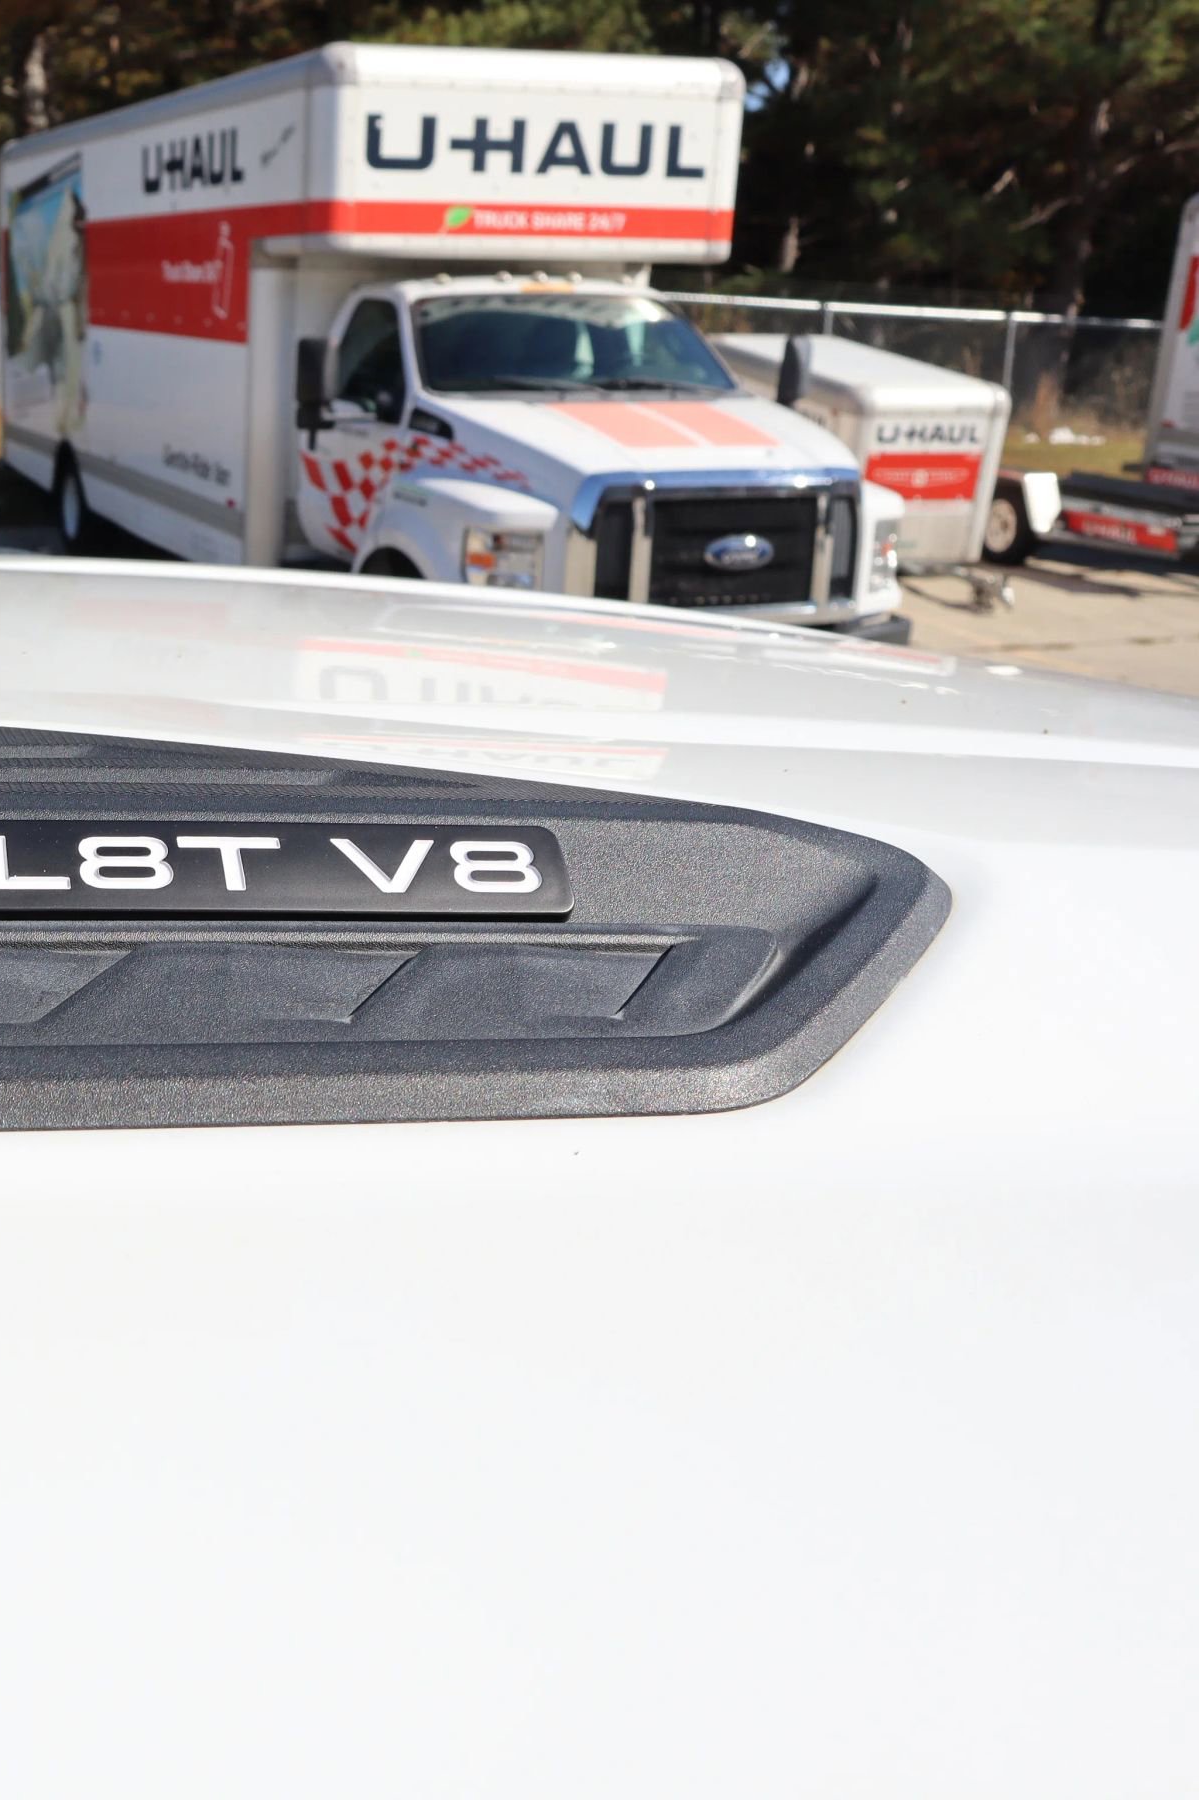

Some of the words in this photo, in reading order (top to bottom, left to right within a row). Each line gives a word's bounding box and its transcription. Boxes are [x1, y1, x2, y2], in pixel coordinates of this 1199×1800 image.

[142, 127, 245, 194] U-HAUL
[366, 113, 704, 178] U-HAUL
[876, 422, 978, 444] U-HAUL
[329, 837, 543, 894] V8
